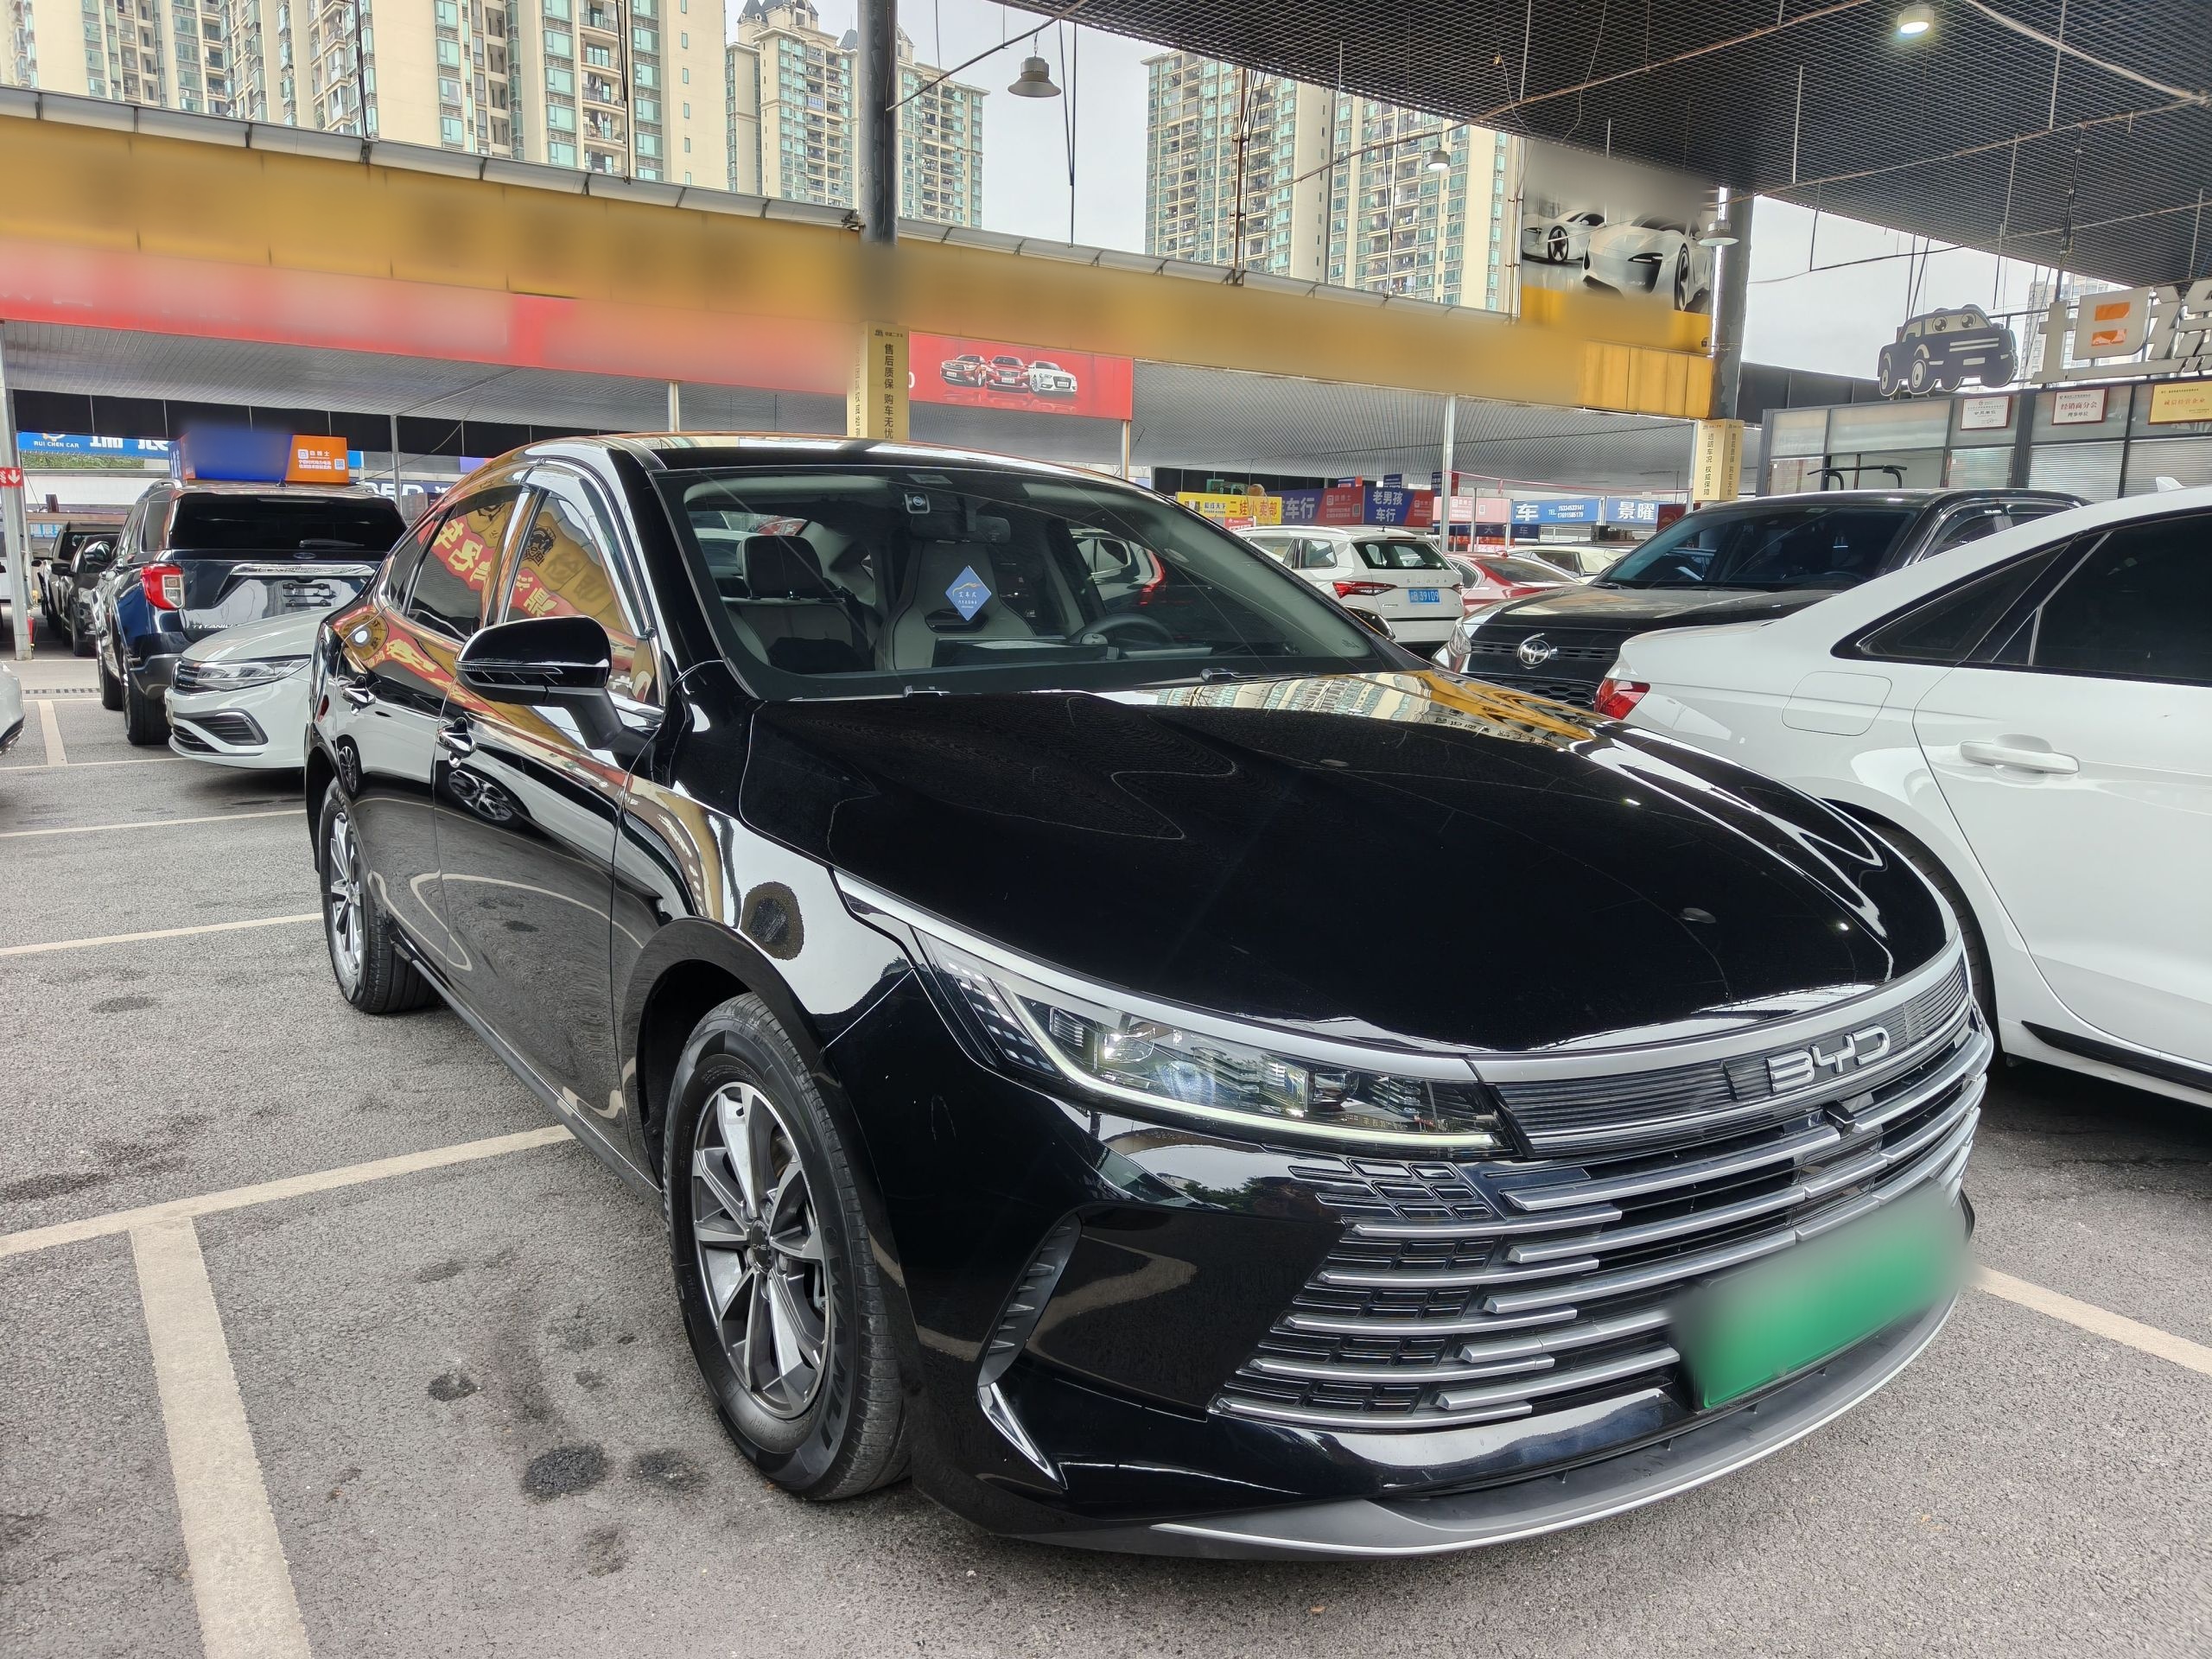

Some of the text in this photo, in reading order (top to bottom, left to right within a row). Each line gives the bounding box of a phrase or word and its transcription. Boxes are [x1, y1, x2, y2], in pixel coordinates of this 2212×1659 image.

[885, 344, 893, 439] 售后质保 购车无忧
[1373, 491, 1403, 505] 老男孩
[1230, 500, 1277, 517] 二娃小卖部
[1282, 497, 1314, 518] 车行
[1376, 507, 1396, 522] 车行
[1516, 504, 1539, 521] 车
[1618, 502, 1654, 520] 景曜
[1767, 1027, 1891, 1092] BYD
